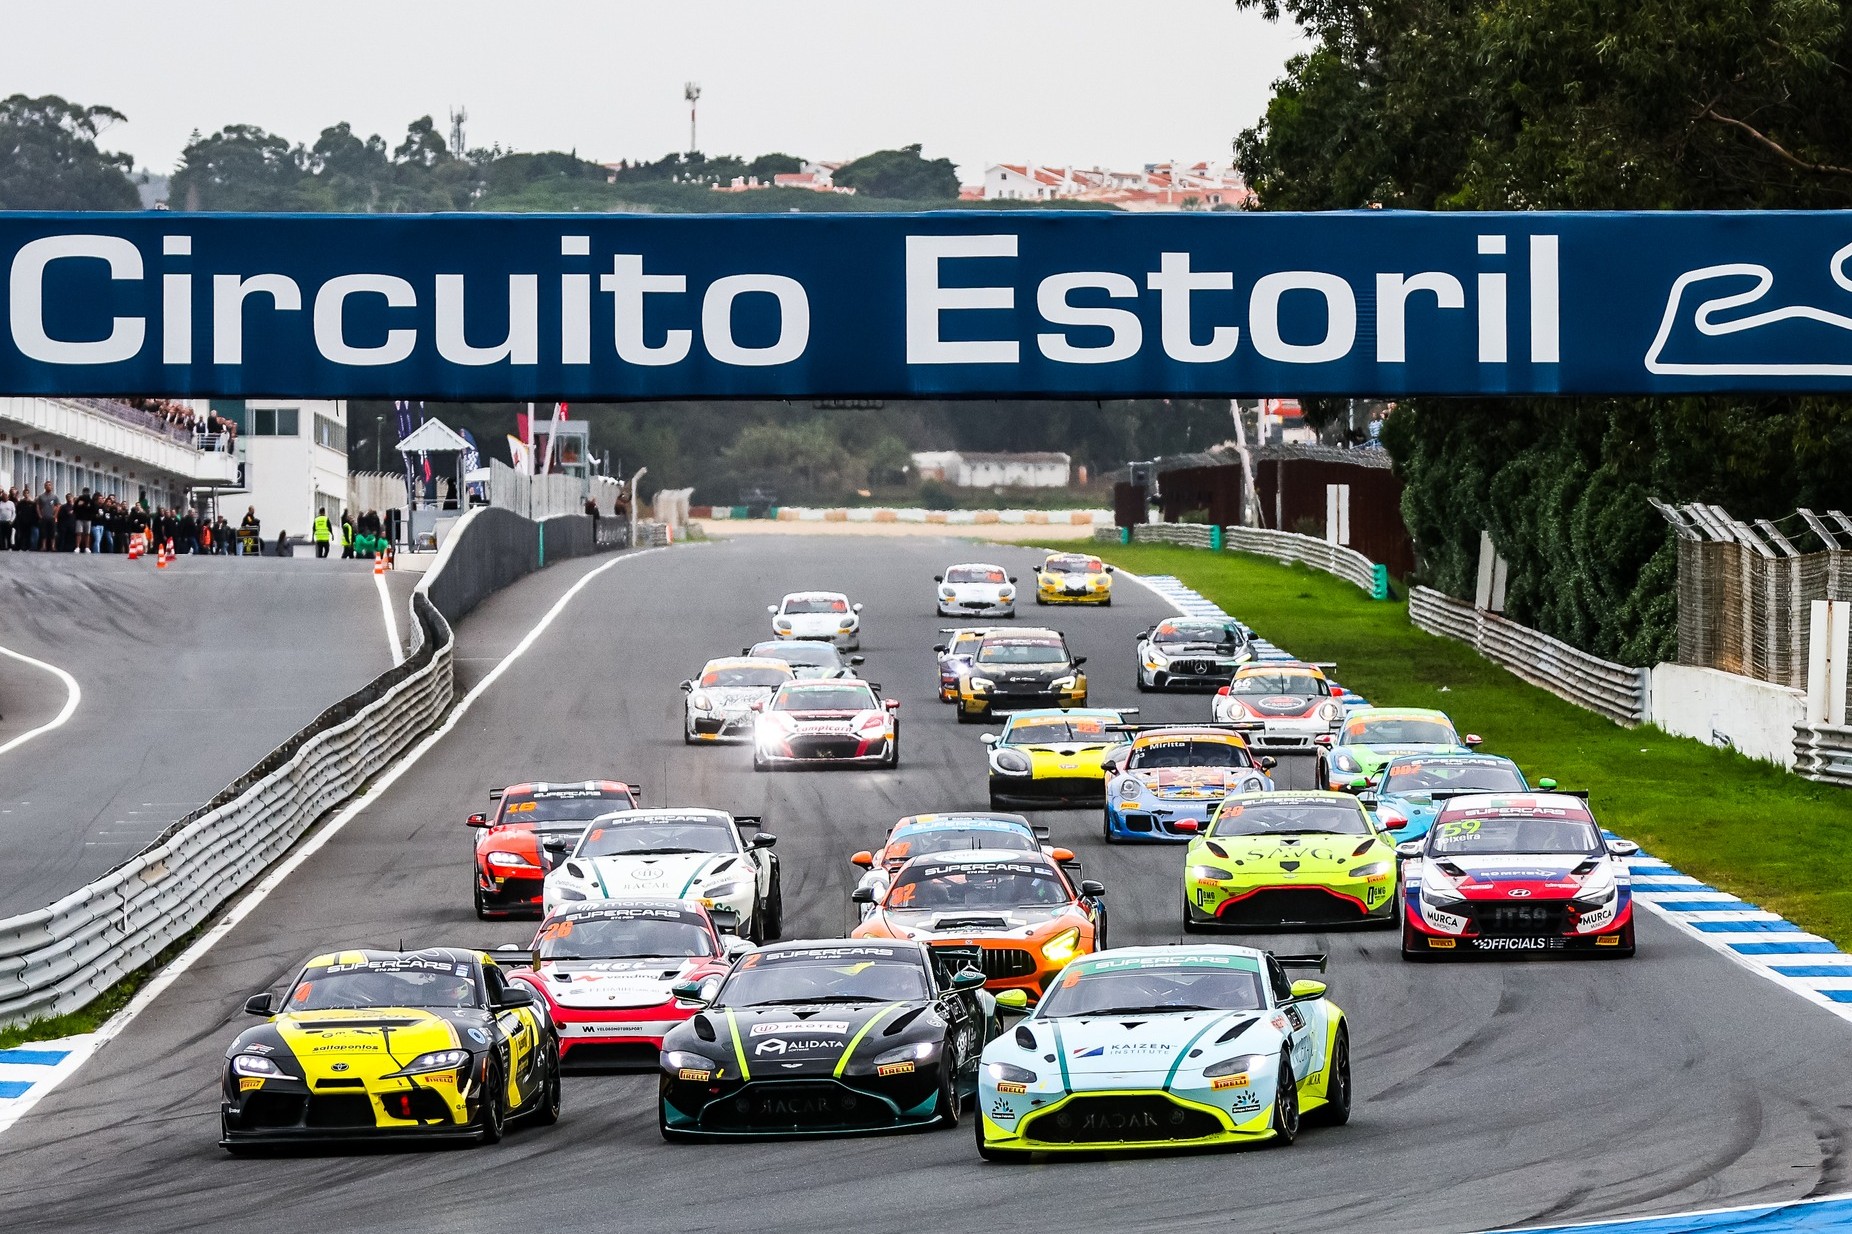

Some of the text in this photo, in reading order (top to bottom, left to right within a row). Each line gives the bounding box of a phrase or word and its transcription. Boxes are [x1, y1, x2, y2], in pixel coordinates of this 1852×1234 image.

[10, 234, 1559, 365] Circuito Estoril
[1150, 742, 1185, 750] Miritta
[1411, 758, 1497, 766] SUPERCARS
[1242, 798, 1336, 806] SUPERCARS
[1465, 808, 1566, 816] SUPERCARS
[612, 816, 708, 824] SUPERCARS
[1444, 820, 1481, 837] 59
[925, 864, 1032, 875] SUPERCARS
[566, 909, 680, 921] SUPERCARS
[543, 921, 574, 940] 26
[766, 948, 894, 960] SUPERCARS
[327, 960, 452, 973] SUPERCARS
[742, 954, 762, 969] 2
[1095, 956, 1229, 969] SUPERCARS
[879, 1062, 915, 1075] PIRELLI
[680, 1070, 711, 1081] PIRELLI
[1214, 1076, 1246, 1088] PIRELLI
[997, 1083, 1026, 1094] PIRELLI
